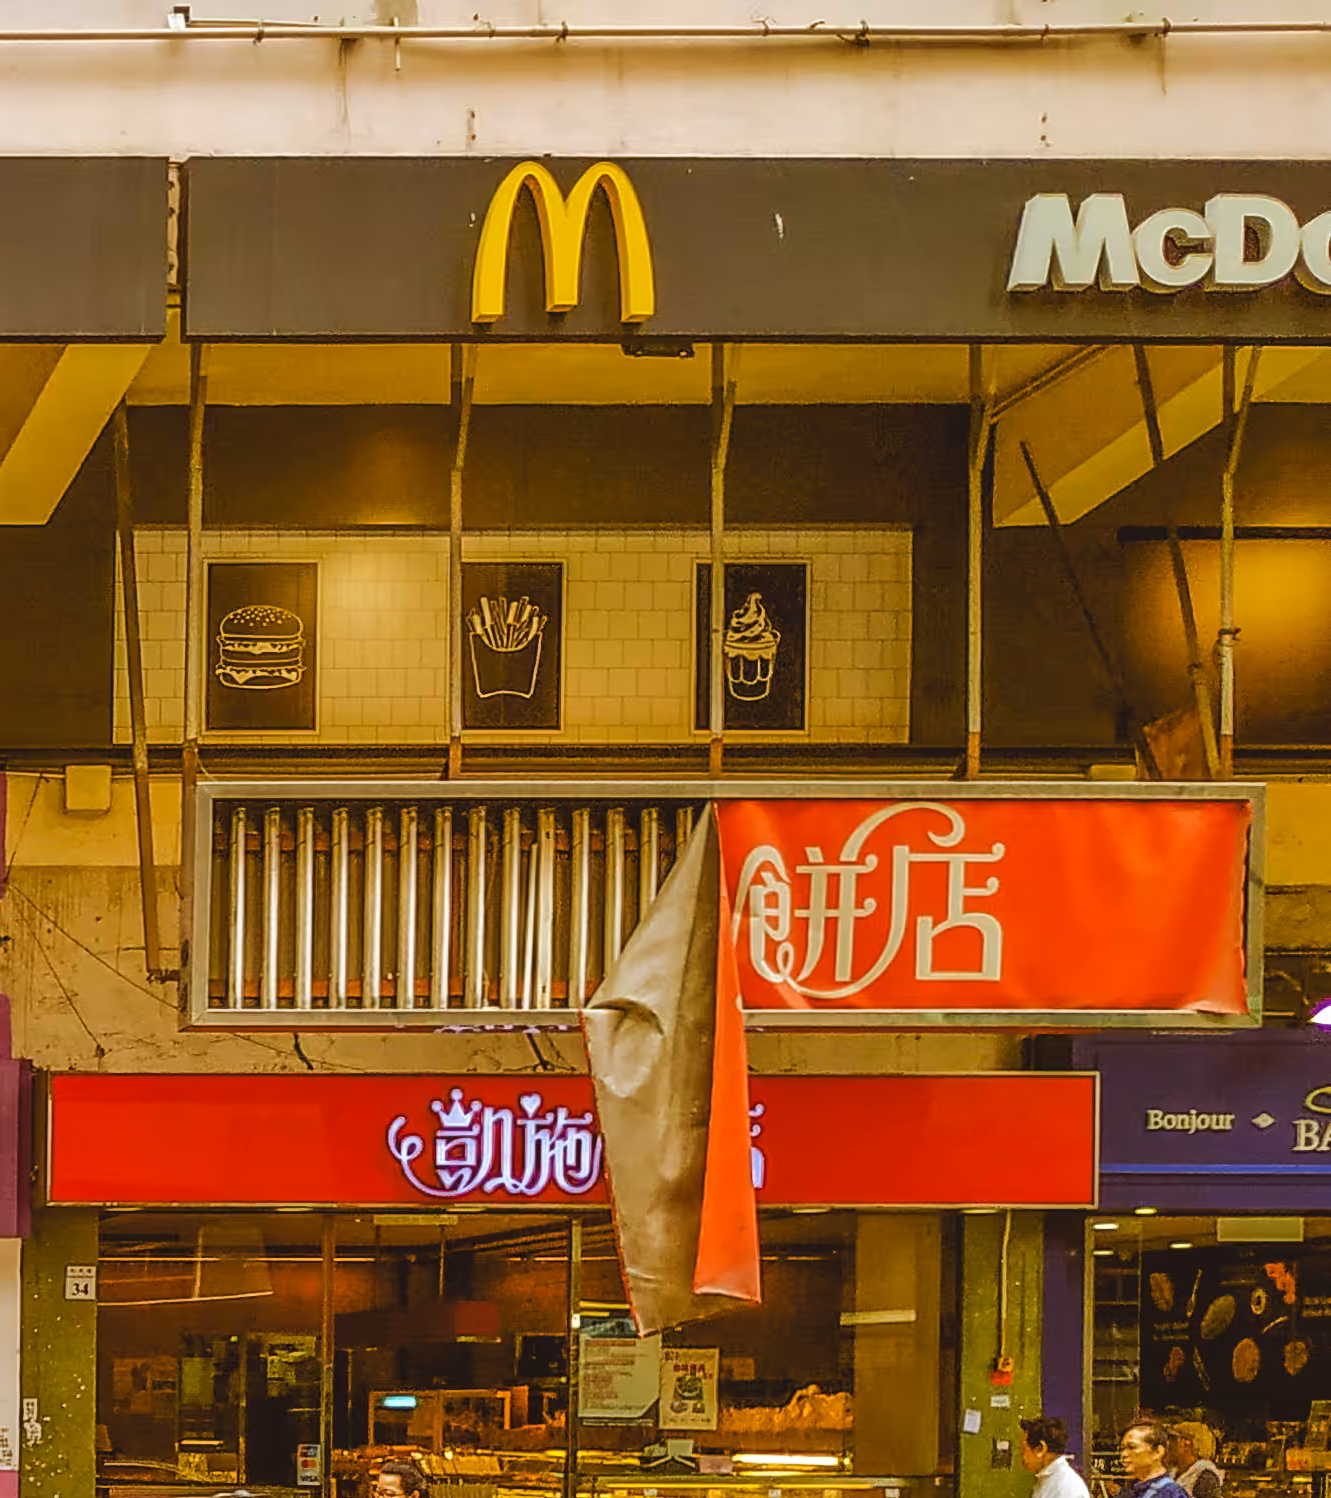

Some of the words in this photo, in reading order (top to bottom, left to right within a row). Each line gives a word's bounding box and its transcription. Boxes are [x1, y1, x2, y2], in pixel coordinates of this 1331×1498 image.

[732, 801, 1006, 1000] 餅店
[1145, 1109, 1236, 1135] Bonjour
[71, 1282, 89, 1297] 34
